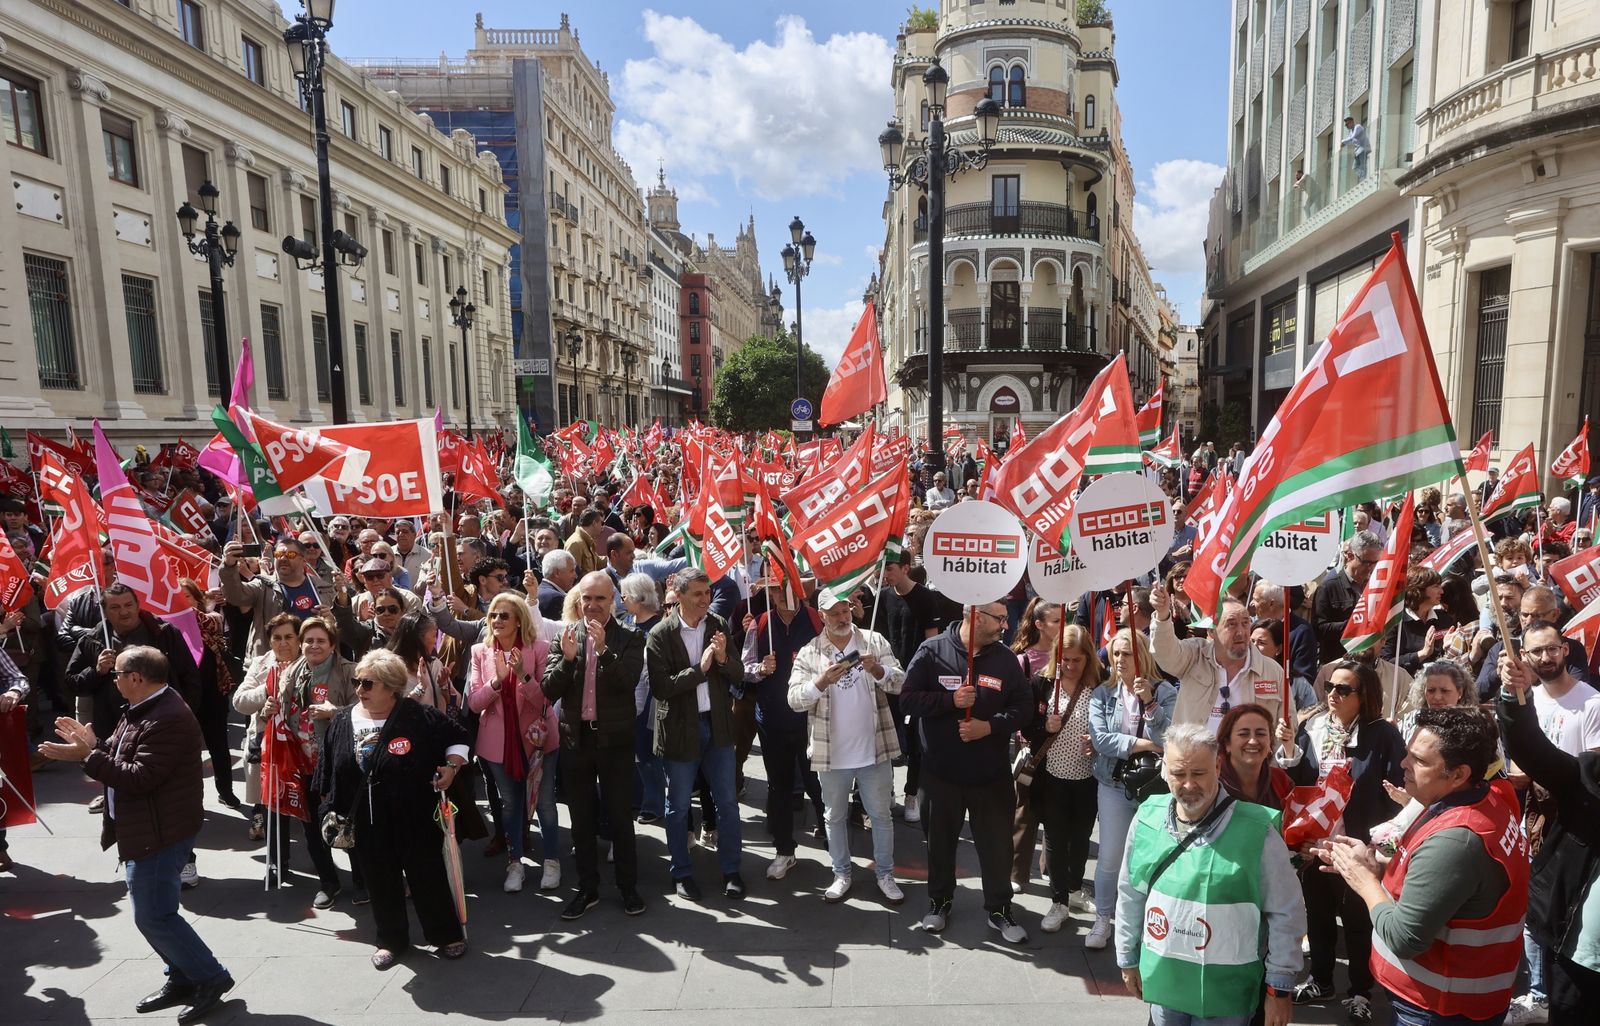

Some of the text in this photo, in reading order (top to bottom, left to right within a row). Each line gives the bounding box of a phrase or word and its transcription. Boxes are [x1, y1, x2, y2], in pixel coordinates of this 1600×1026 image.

[333, 471, 422, 505] PSOE
[1082, 509, 1139, 532] CCOO
[937, 537, 992, 553] CCOO
[943, 556, 1007, 575] hábitat
[295, 597, 309, 607] UGT
[389, 740, 409, 750] UGT
[1147, 909, 1167, 929] UGT
